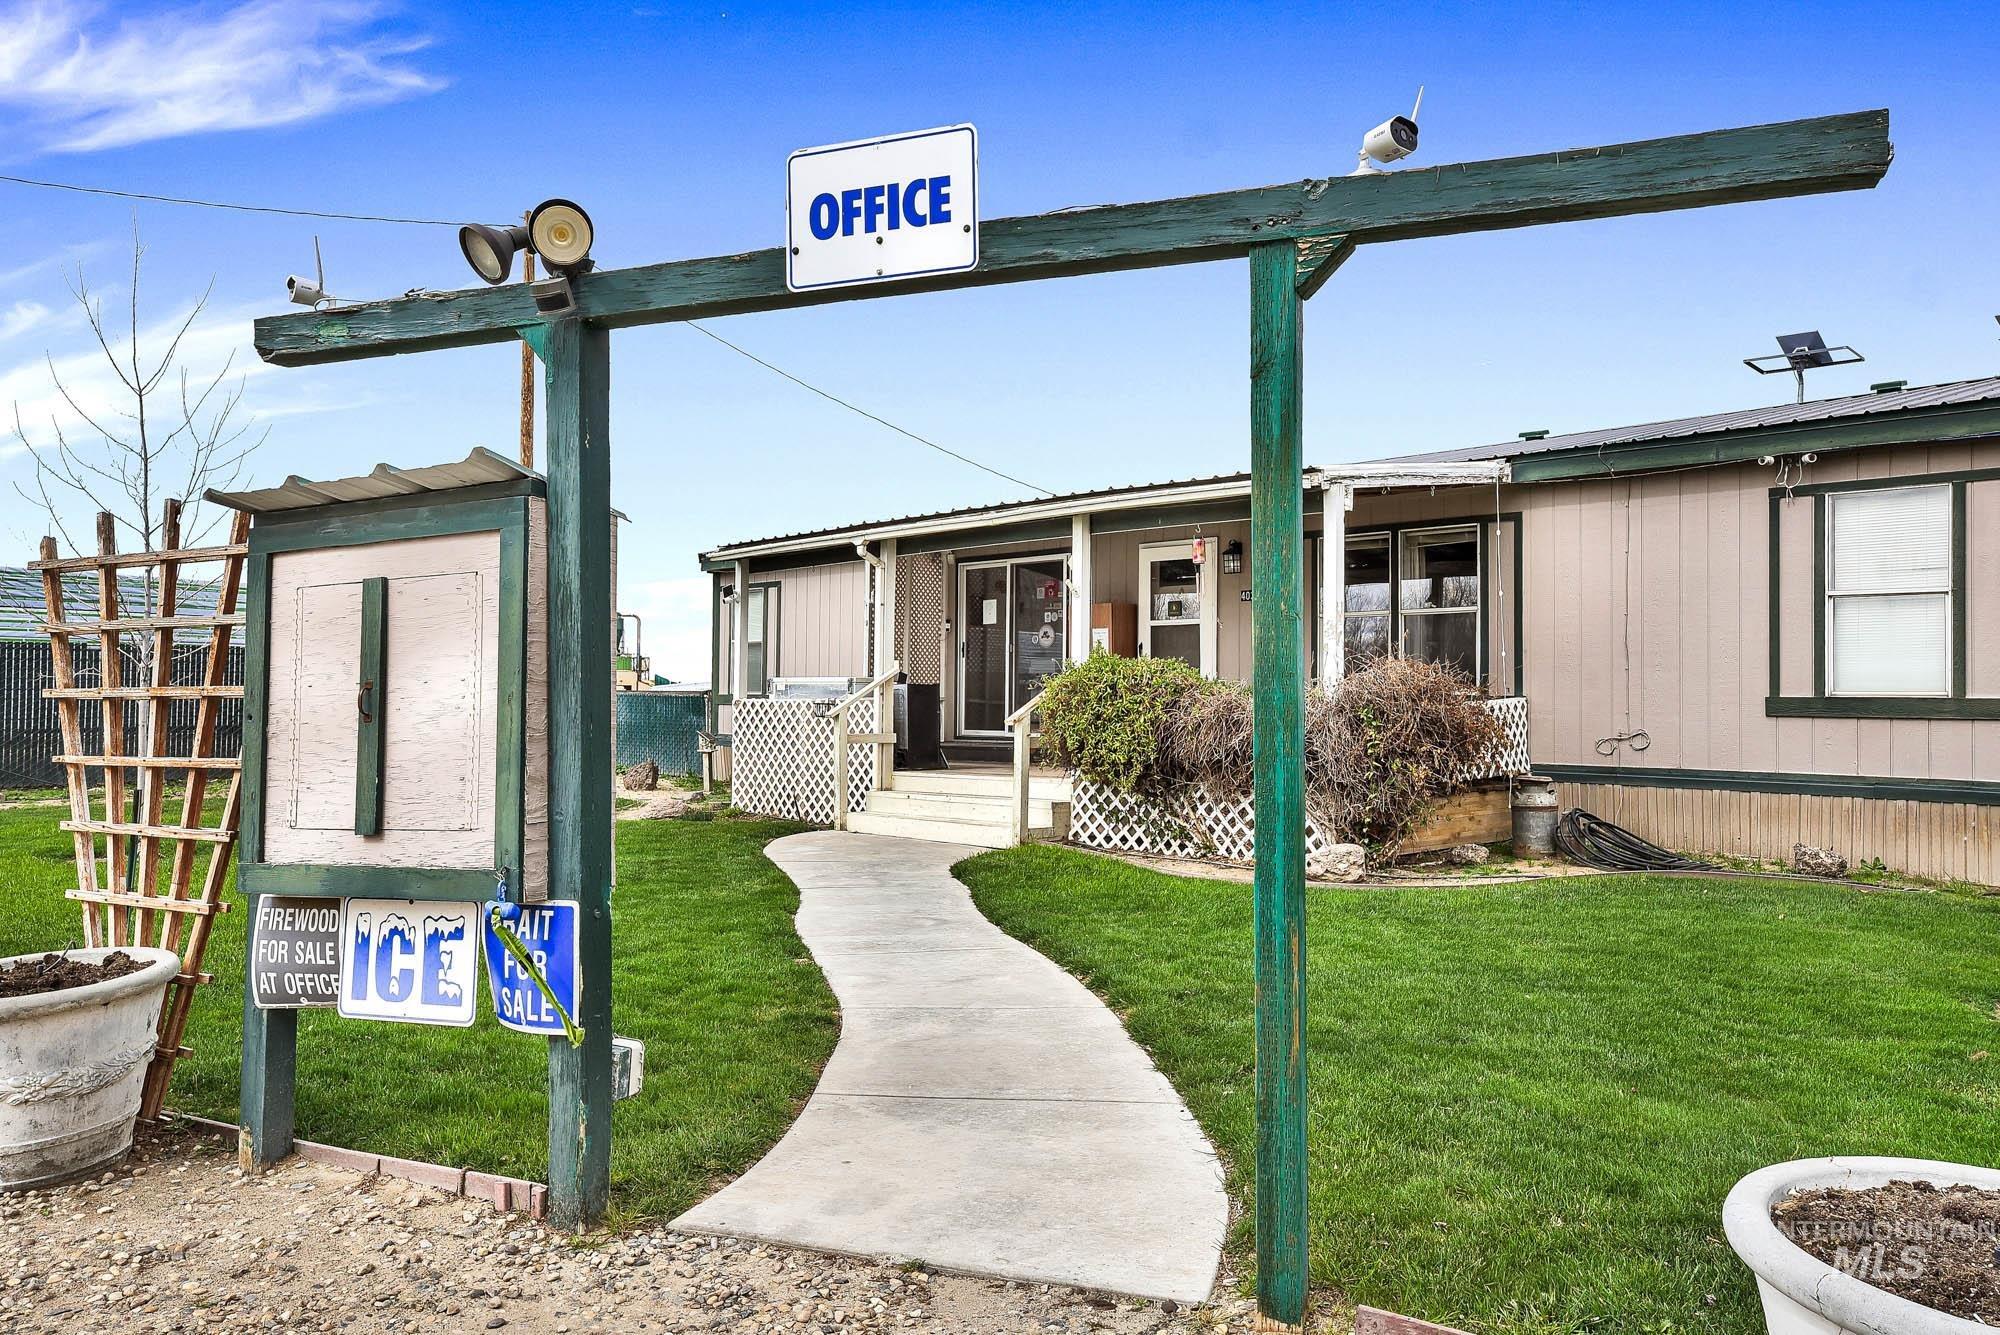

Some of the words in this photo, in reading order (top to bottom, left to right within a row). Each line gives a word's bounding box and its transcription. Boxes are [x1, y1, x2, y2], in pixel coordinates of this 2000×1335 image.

[809, 175, 951, 240] OFFICE
[259, 907, 339, 933] FIREWOOD
[258, 940, 289, 964] FOR
[294, 940, 336, 965] SALE
[351, 912, 465, 1007] ICE
[260, 972, 277, 994] AT
[284, 972, 339, 995] OFFICE
[501, 986, 554, 1022] SALE
